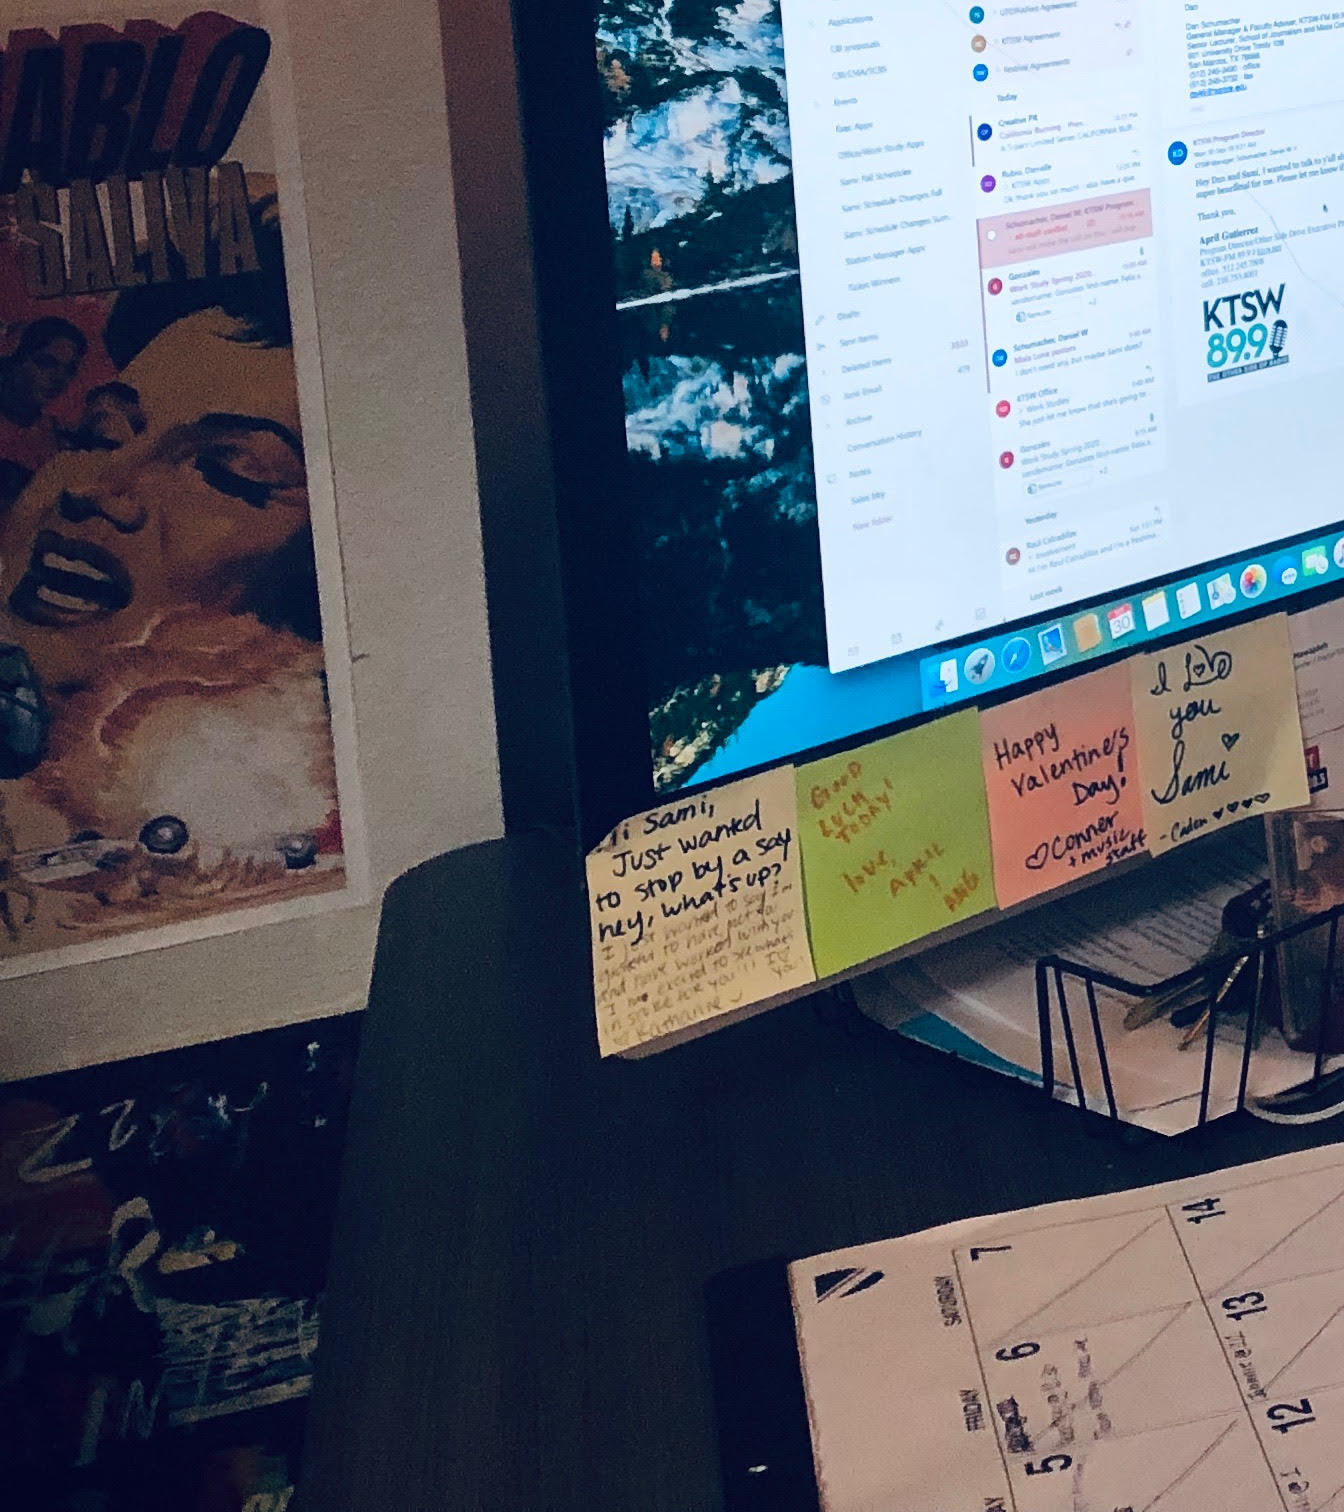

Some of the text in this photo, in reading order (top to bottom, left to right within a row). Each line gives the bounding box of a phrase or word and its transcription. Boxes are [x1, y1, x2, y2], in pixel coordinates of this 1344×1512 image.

[0, 18, 272, 194] ABLO
[996, 92, 1018, 103] Today
[1198, 210, 1219, 222] Thank
[1199, 225, 1259, 245] April Gutierrez
[1203, 283, 1285, 332] KTSW
[1207, 323, 1268, 368] 89.9
[1113, 614, 1131, 635] 30
[1170, 698, 1221, 739] you
[994, 723, 1060, 770] Happy
[1151, 740, 1231, 805] Sami
[612, 798, 763, 878] Just wanted
[1080, 827, 1130, 866] music
[1105, 829, 1148, 866] staff
[596, 828, 792, 912] to stop by a say
[747, 861, 783, 889] up?
[1181, 1196, 1227, 1226] 14
[970, 1245, 1012, 1263] 7
[1222, 1290, 1269, 1323] 13
[995, 1341, 1041, 1363] 6
[1265, 1397, 1316, 1435] 12
[1025, 1453, 1073, 1477] 5
